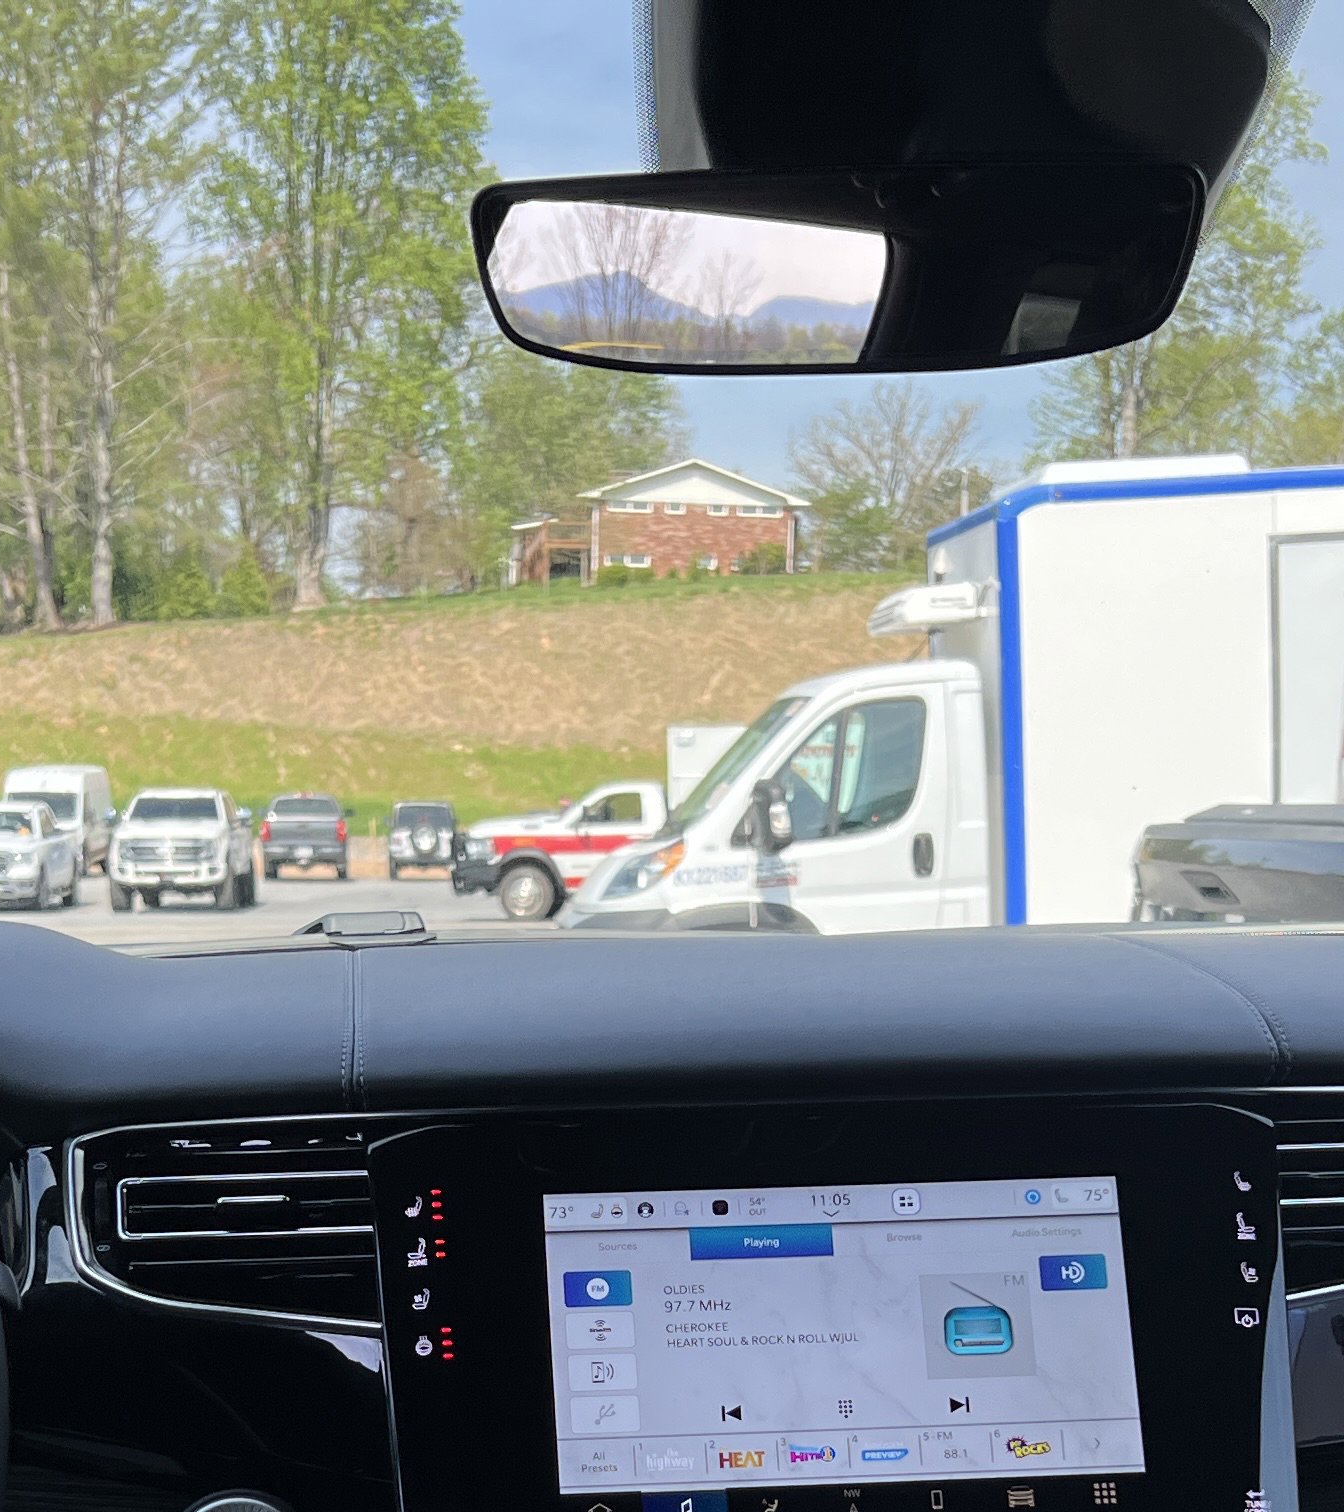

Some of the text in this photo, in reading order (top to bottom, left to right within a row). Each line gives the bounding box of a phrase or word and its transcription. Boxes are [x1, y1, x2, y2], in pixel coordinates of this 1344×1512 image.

[811, 1193, 851, 1207] 11:05
[1083, 1188, 1109, 1201] 75°
[549, 1206, 574, 1219] 73°
[749, 1208, 766, 1216] OUT
[887, 1232, 922, 1243] Browse
[1012, 1227, 1082, 1238] Audio Settings
[598, 1241, 638, 1251] Sources
[744, 1237, 780, 1249] Playing
[1004, 1274, 1025, 1286] FM
[591, 1284, 605, 1293] FM
[663, 1284, 705, 1295] OLDIES
[664, 1299, 732, 1313] 97.7 MHz
[666, 1321, 729, 1333] CHEROKEE
[667, 1337, 705, 1348] HEART
[707, 1336, 738, 1347] SOUL
[740, 1336, 749, 1346] &
[751, 1334, 783, 1345] ROCK
[786, 1334, 796, 1345] N
[799, 1333, 828, 1344] ROLL
[923, 1431, 953, 1441] 5 FM
[994, 1430, 1000, 1438] 6
[709, 1440, 716, 1449] 2
[781, 1438, 787, 1446] 3
[593, 1452, 606, 1461] All
[719, 1450, 765, 1468] HEAT
[944, 1449, 969, 1459] 88.1
[646, 1453, 695, 1471] highway
[581, 1463, 618, 1473] Presets
